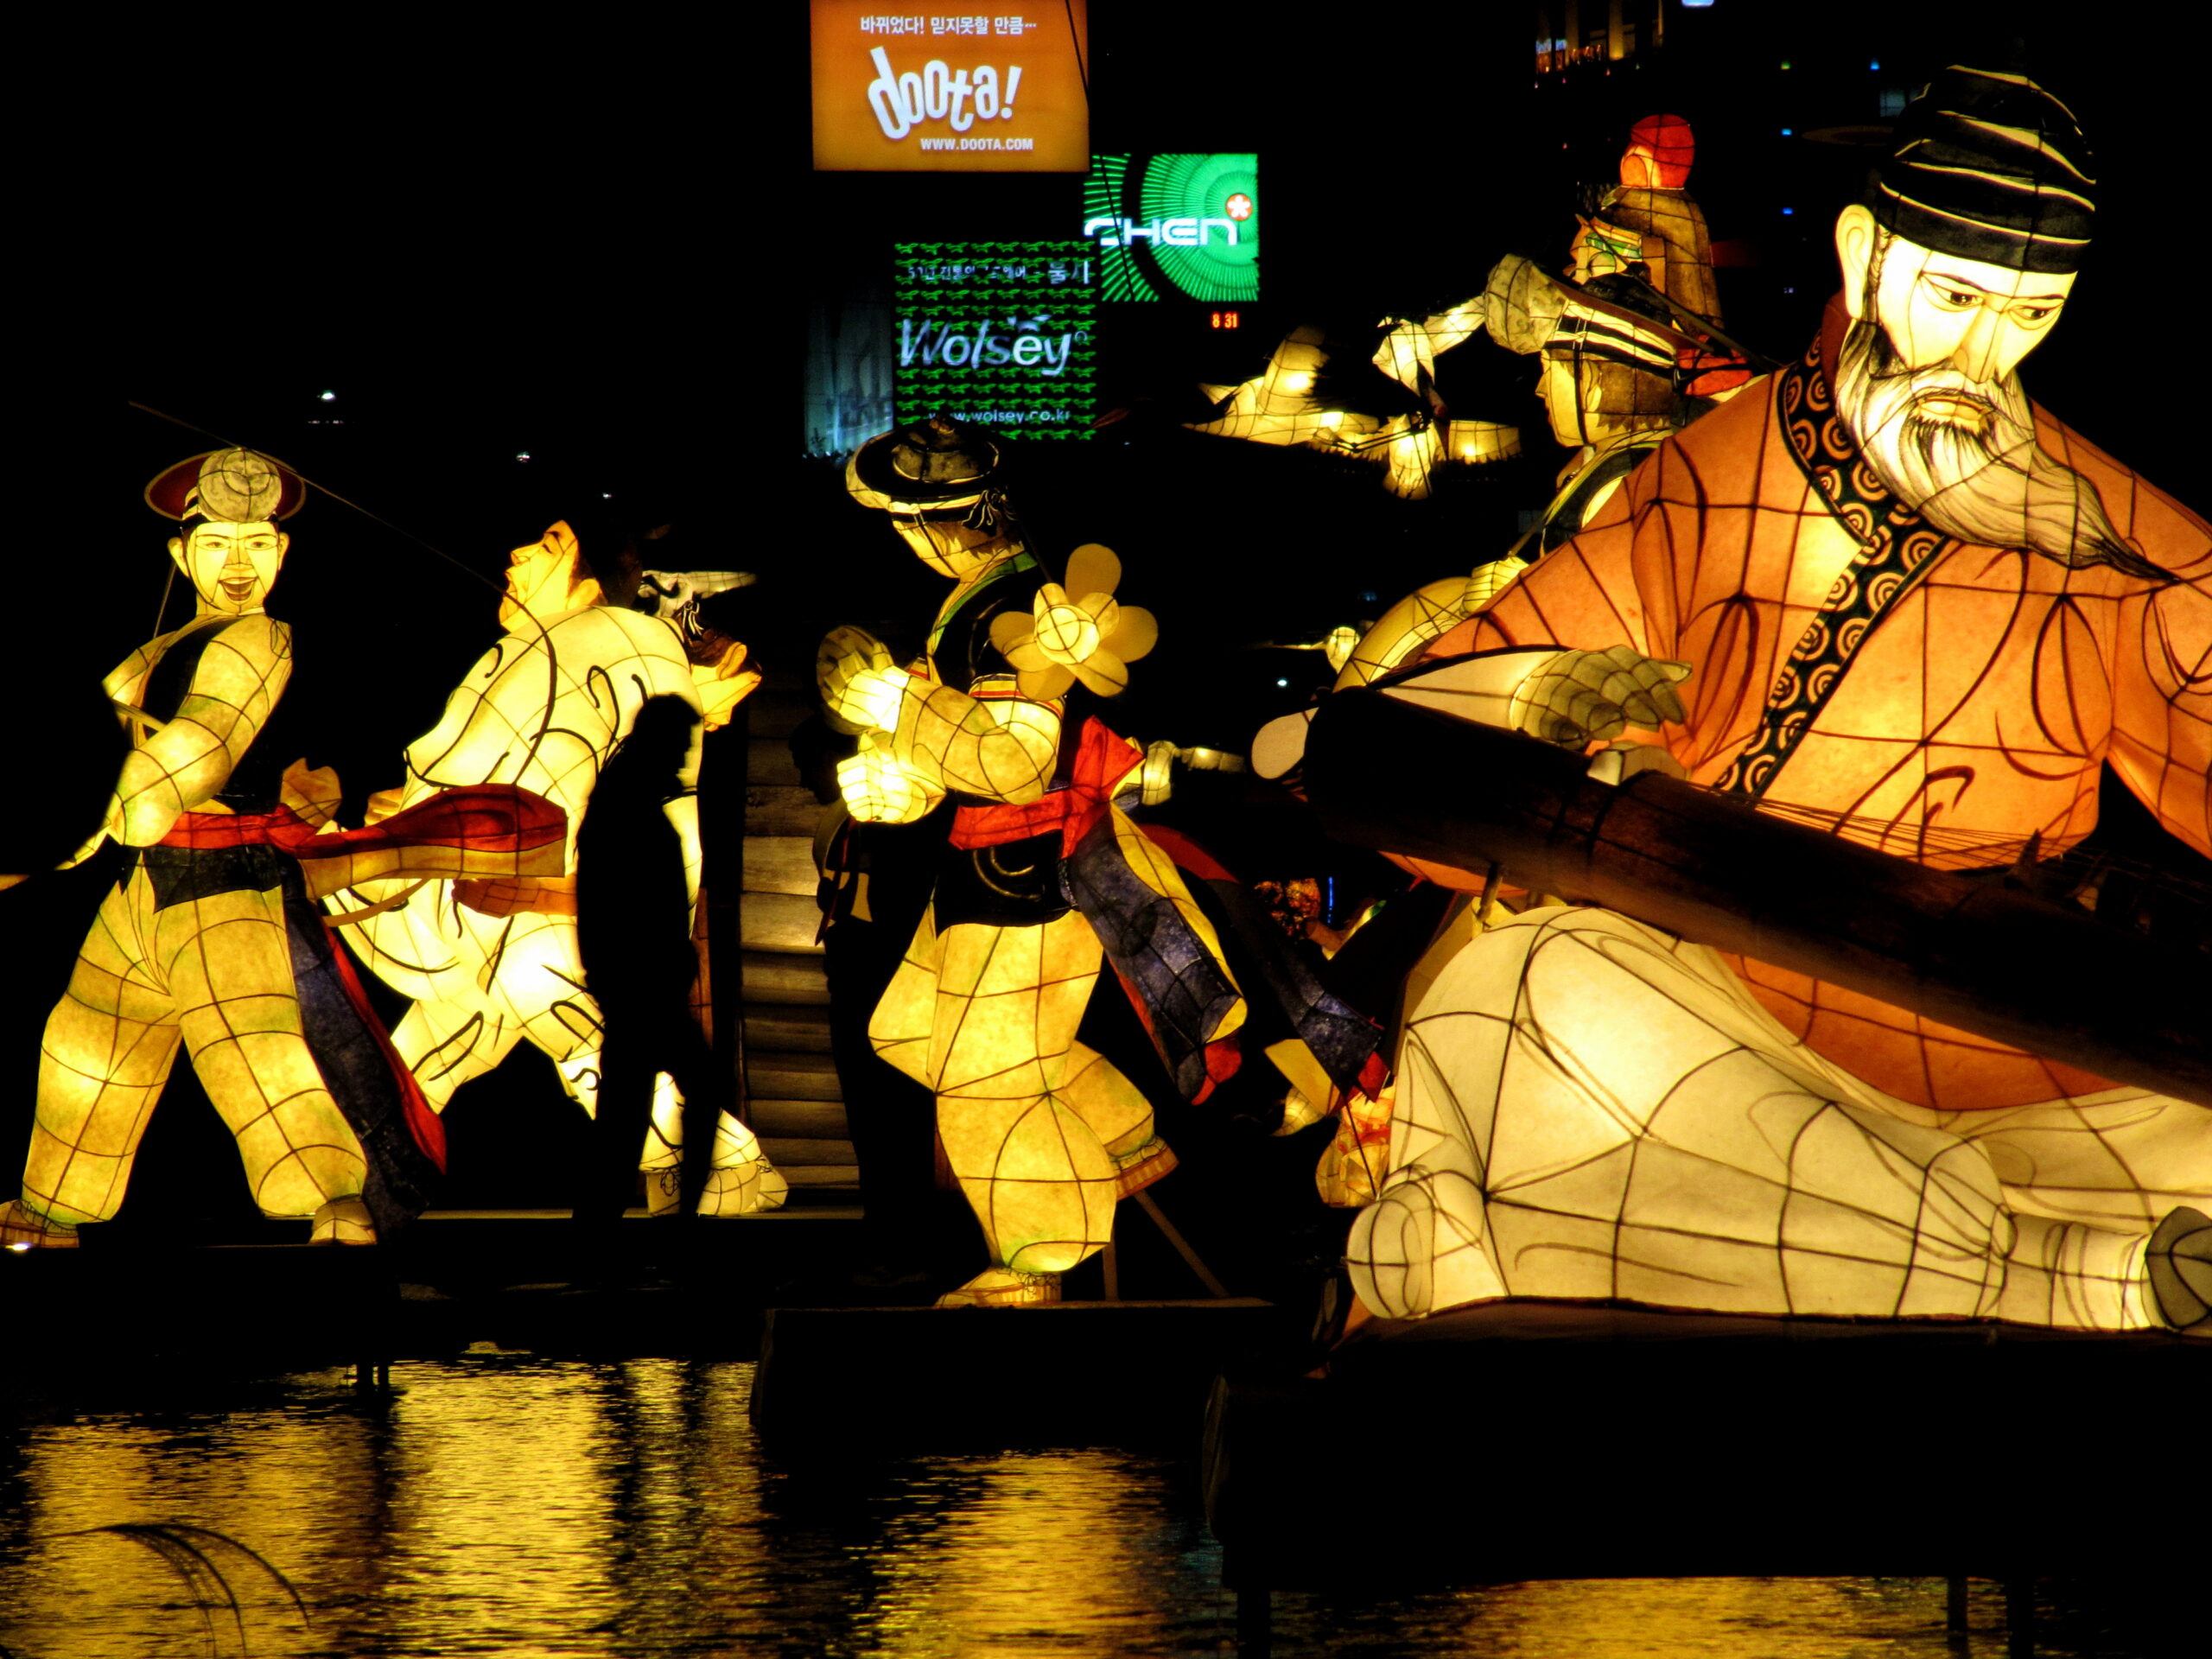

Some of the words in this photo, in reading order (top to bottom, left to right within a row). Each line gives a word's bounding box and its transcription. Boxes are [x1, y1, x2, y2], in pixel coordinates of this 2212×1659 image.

[861, 16, 925, 35] 바뀌었다!
[931, 16, 989, 35] 믿지못할
[868, 46, 1022, 140] doota!
[920, 138, 1034, 150] WWW.DOOTA.COM
[900, 318, 1072, 376] Wolsey
